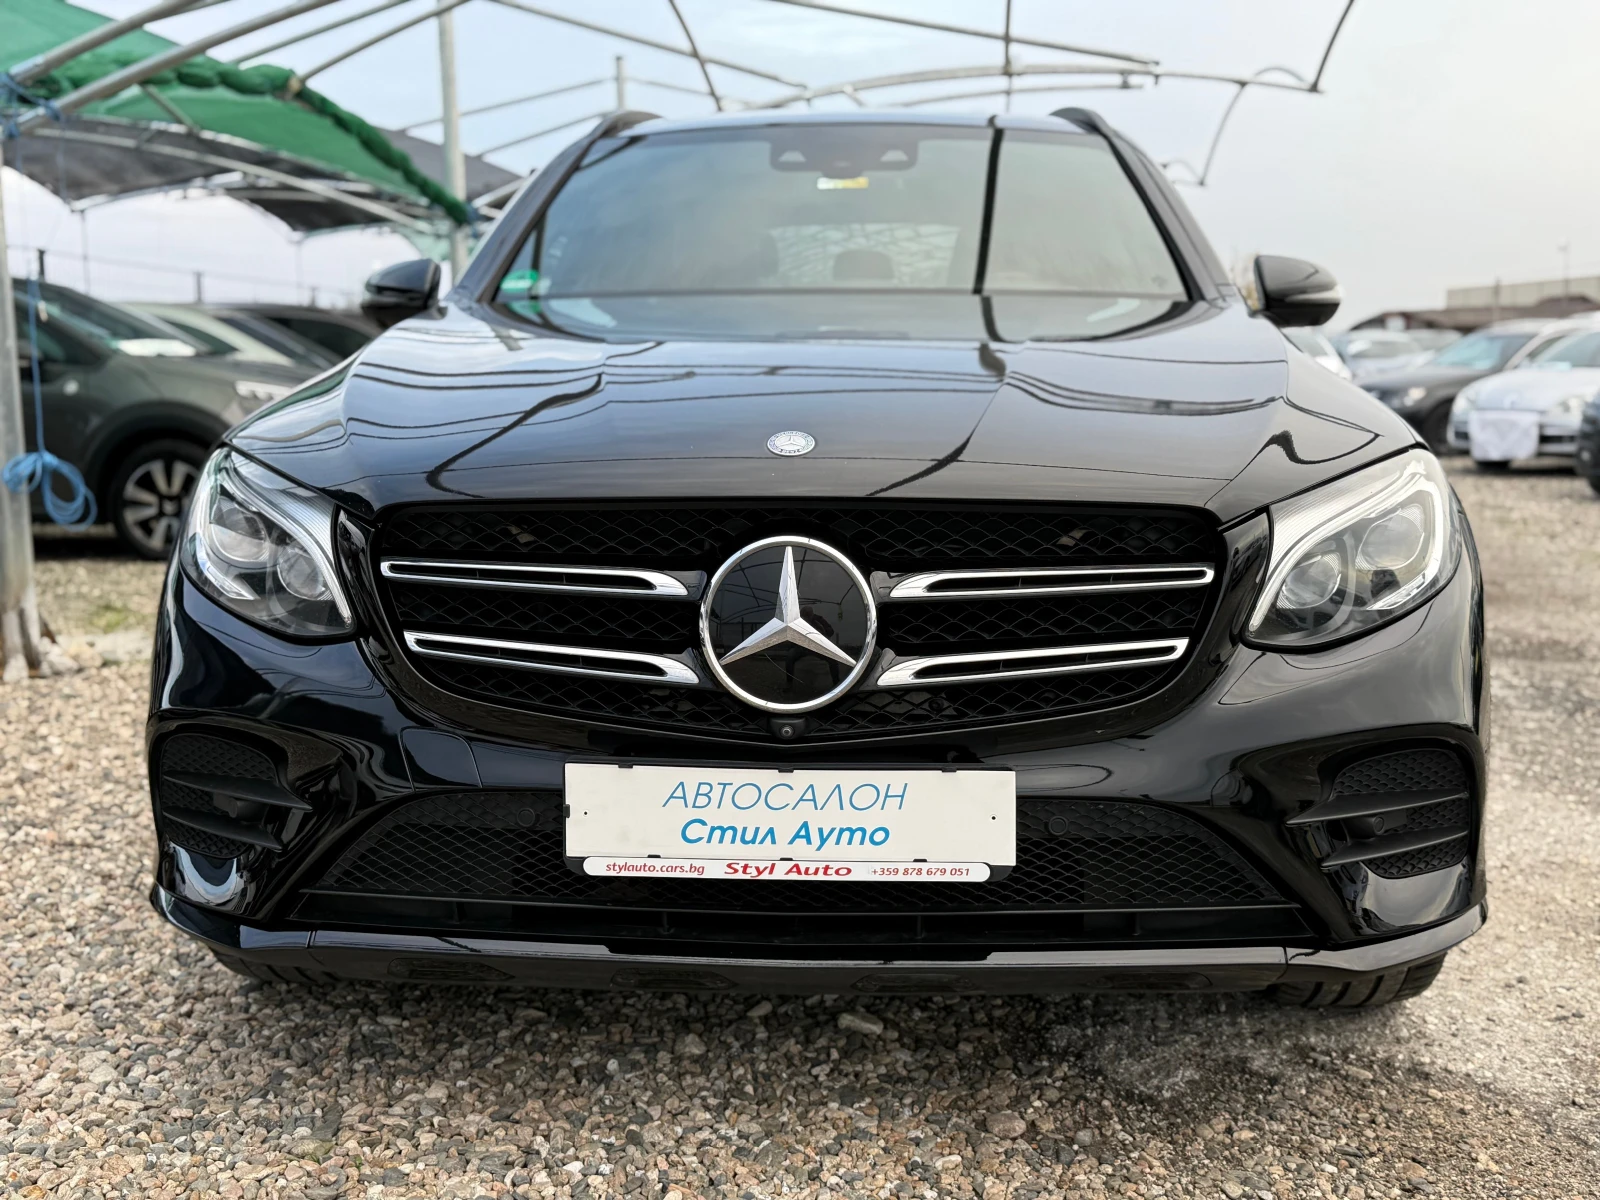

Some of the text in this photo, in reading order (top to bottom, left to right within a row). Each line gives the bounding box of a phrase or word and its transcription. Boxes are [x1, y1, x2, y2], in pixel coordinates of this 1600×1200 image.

[662, 781, 908, 811] АВТОСАЛОН
[605, 861, 970, 878] stylauto.cars.bg Styl Auto +359 878 679 051
